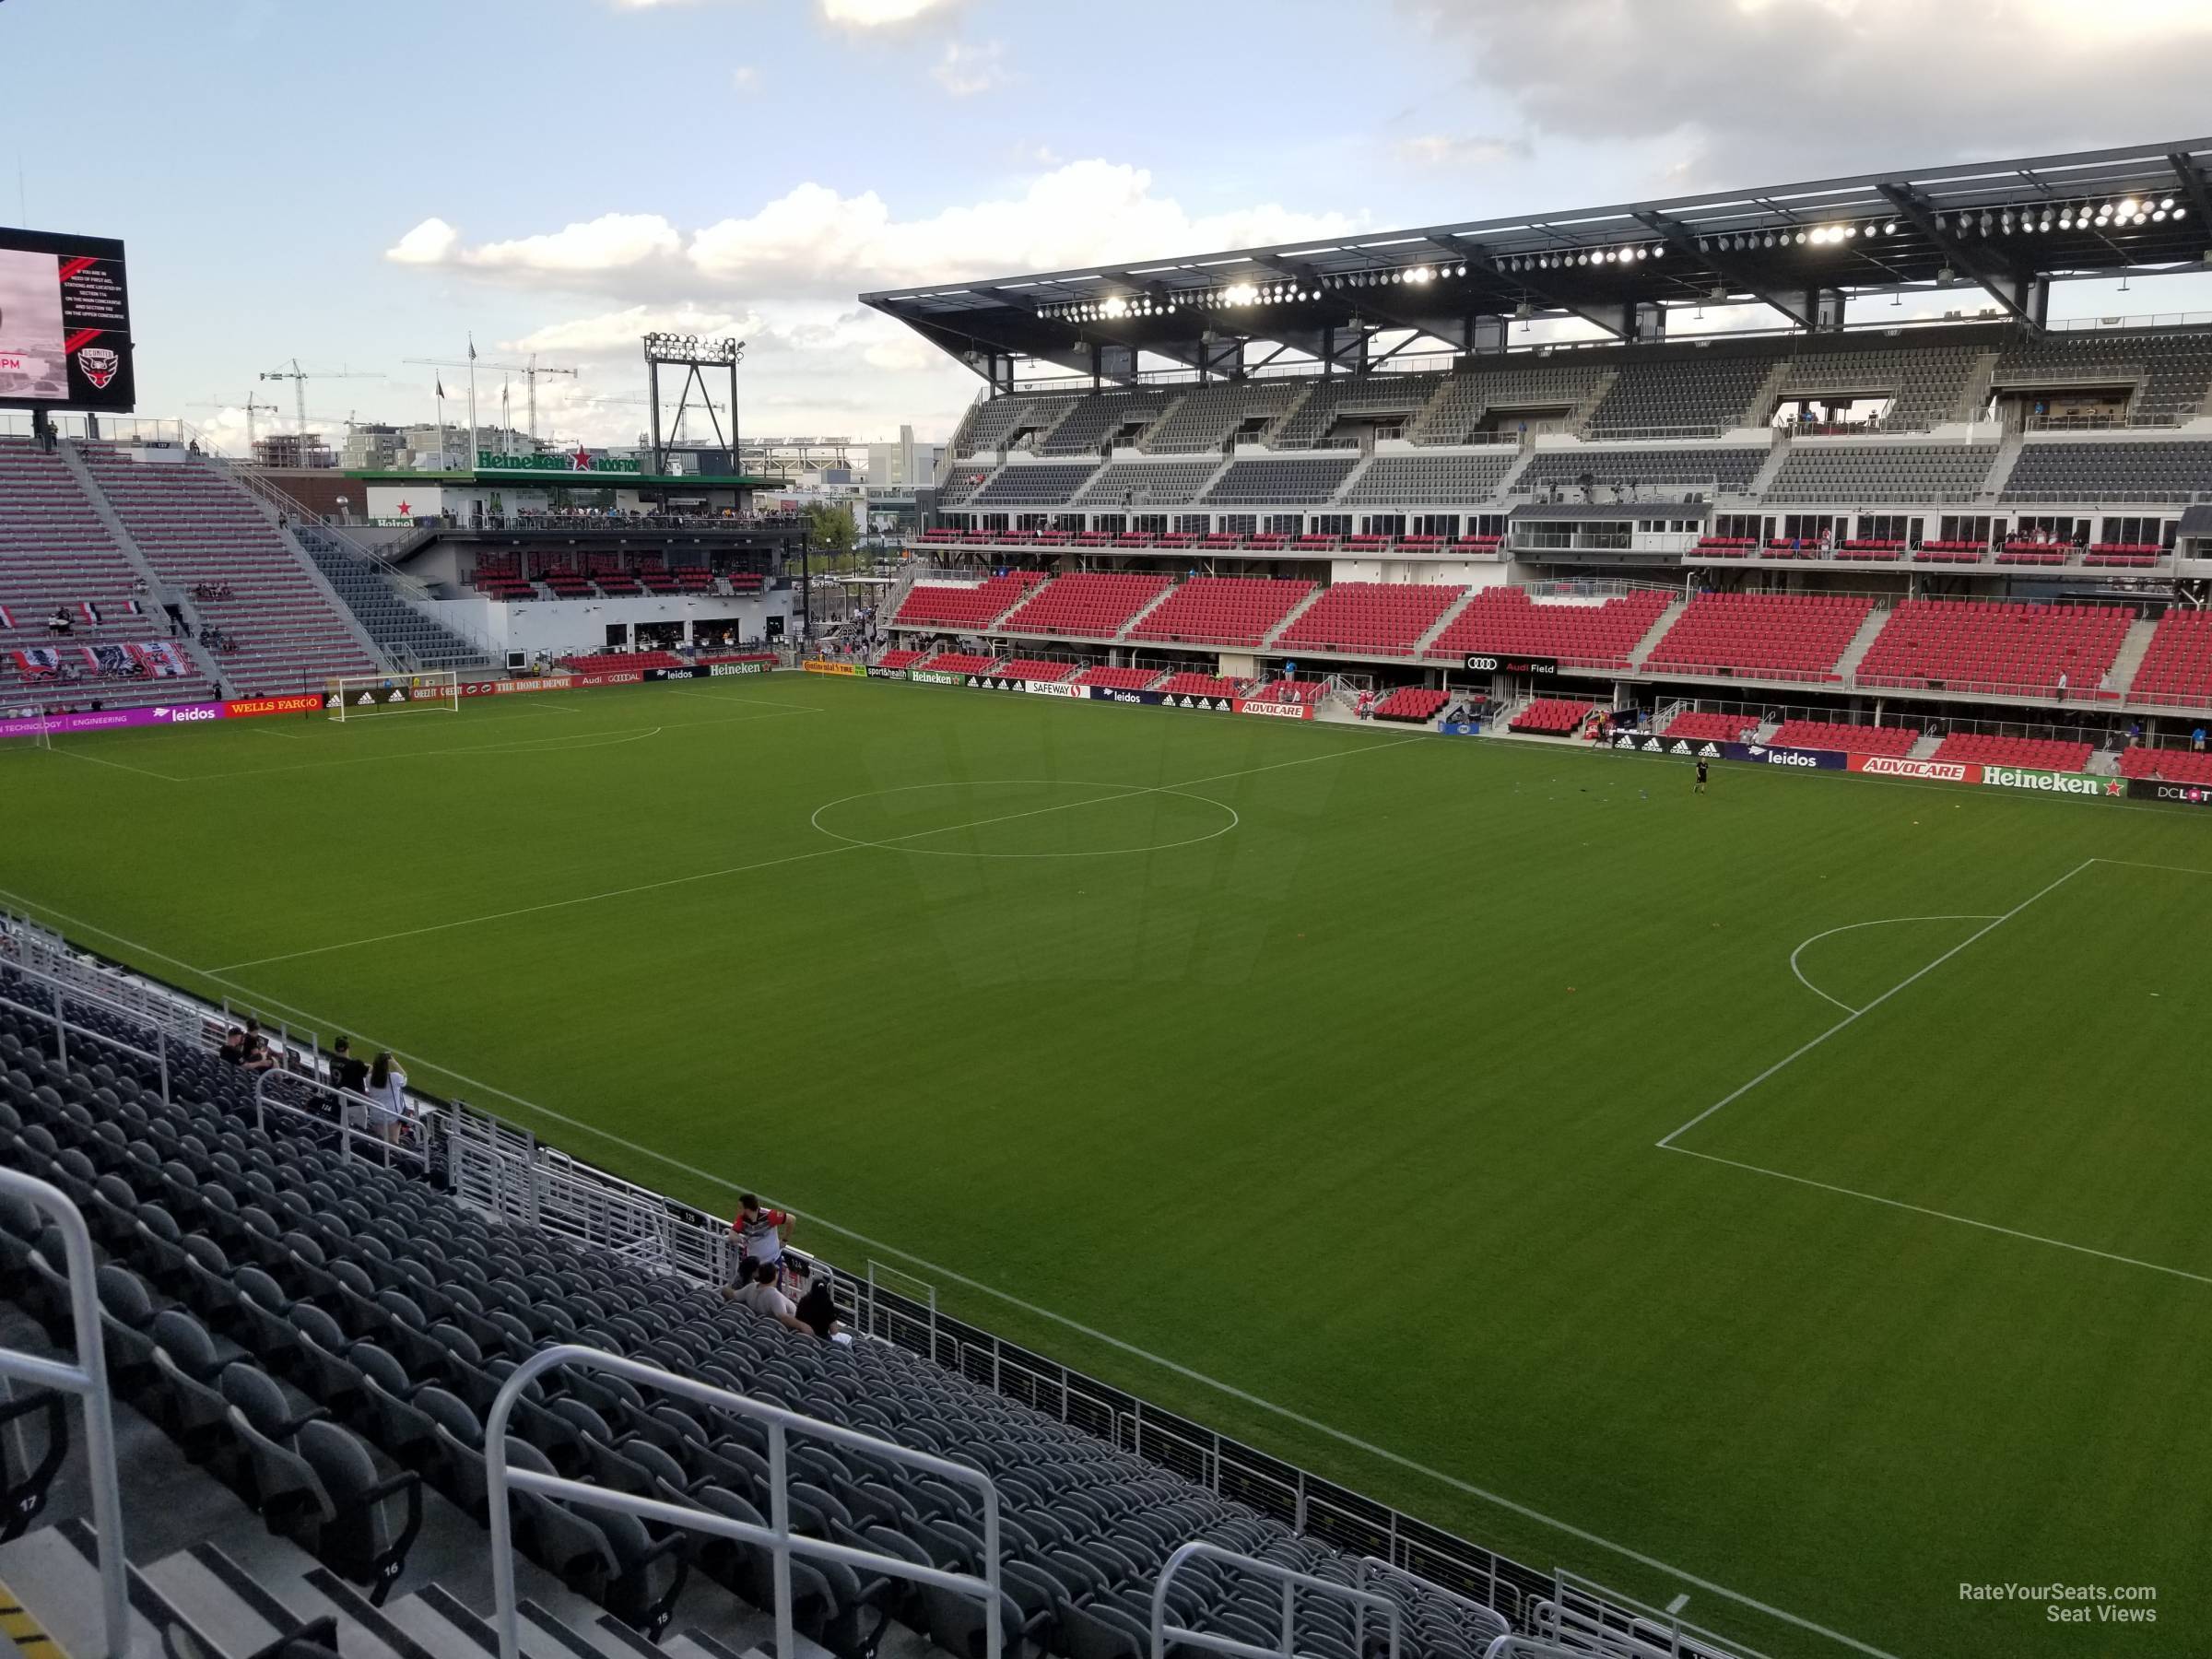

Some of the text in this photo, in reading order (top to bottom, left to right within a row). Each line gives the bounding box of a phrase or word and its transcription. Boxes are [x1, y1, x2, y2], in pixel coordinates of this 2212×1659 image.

[0, 358, 20, 370] PM
[667, 670, 693, 680] leidos
[710, 663, 761, 677] Heineken
[1506, 663, 1554, 674] Audi Field
[496, 682, 515, 692] THE
[516, 680, 541, 690] HOME
[542, 677, 571, 688] DEPOT
[582, 676, 602, 685] Audi
[912, 671, 952, 685] Heineken
[1033, 682, 1071, 696] SAFEWAY
[1114, 690, 1141, 703] leidos
[231, 698, 318, 713] WELLS FARGO
[1243, 701, 1302, 717] ADVOCARE
[172, 707, 216, 723] leidos
[5, 720, 62, 734] TECHNOLOGY
[73, 715, 127, 727] ENGINEERING
[1768, 749, 1817, 768] leidos
[1864, 758, 1965, 780] ADVOCARE
[1982, 765, 2099, 795] Heineken
[685, 1212, 695, 1223] 125
[19, 1497, 37, 1512] 17
[383, 1562, 398, 1577] 16
[657, 1613, 669, 1625] 15
